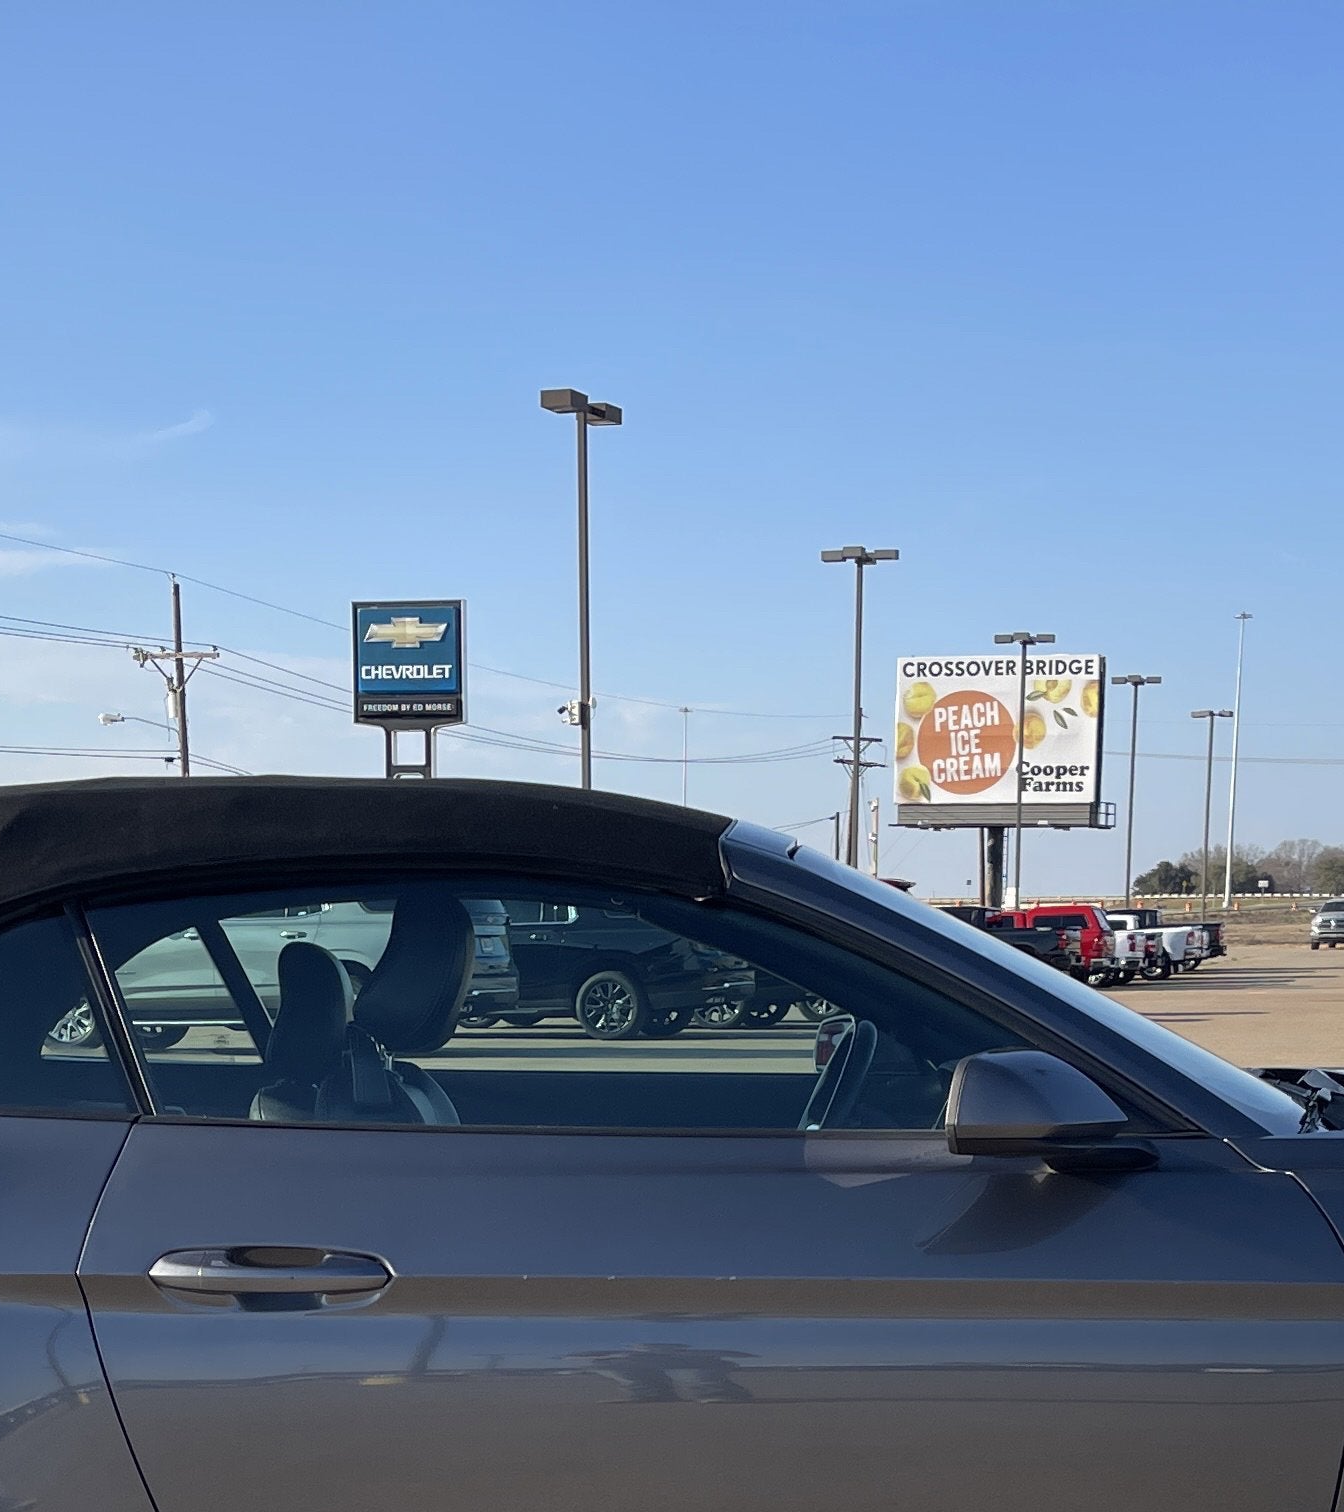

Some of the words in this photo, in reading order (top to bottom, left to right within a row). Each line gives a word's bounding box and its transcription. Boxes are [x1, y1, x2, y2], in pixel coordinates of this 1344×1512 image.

[361, 664, 452, 679] CHEVROLET
[902, 660, 1017, 678] CROSSOVER
[1024, 659, 1094, 676] BRIDGE
[363, 703, 399, 712] FREEDOM
[401, 703, 411, 711] BY
[412, 703, 424, 711] ED
[425, 703, 452, 711] MORSE
[934, 700, 1000, 733] PEACH
[950, 729, 982, 757] ICE
[932, 752, 1002, 784] CREAM
[1016, 761, 1090, 780] Cooper
[1021, 777, 1084, 793] Farms
